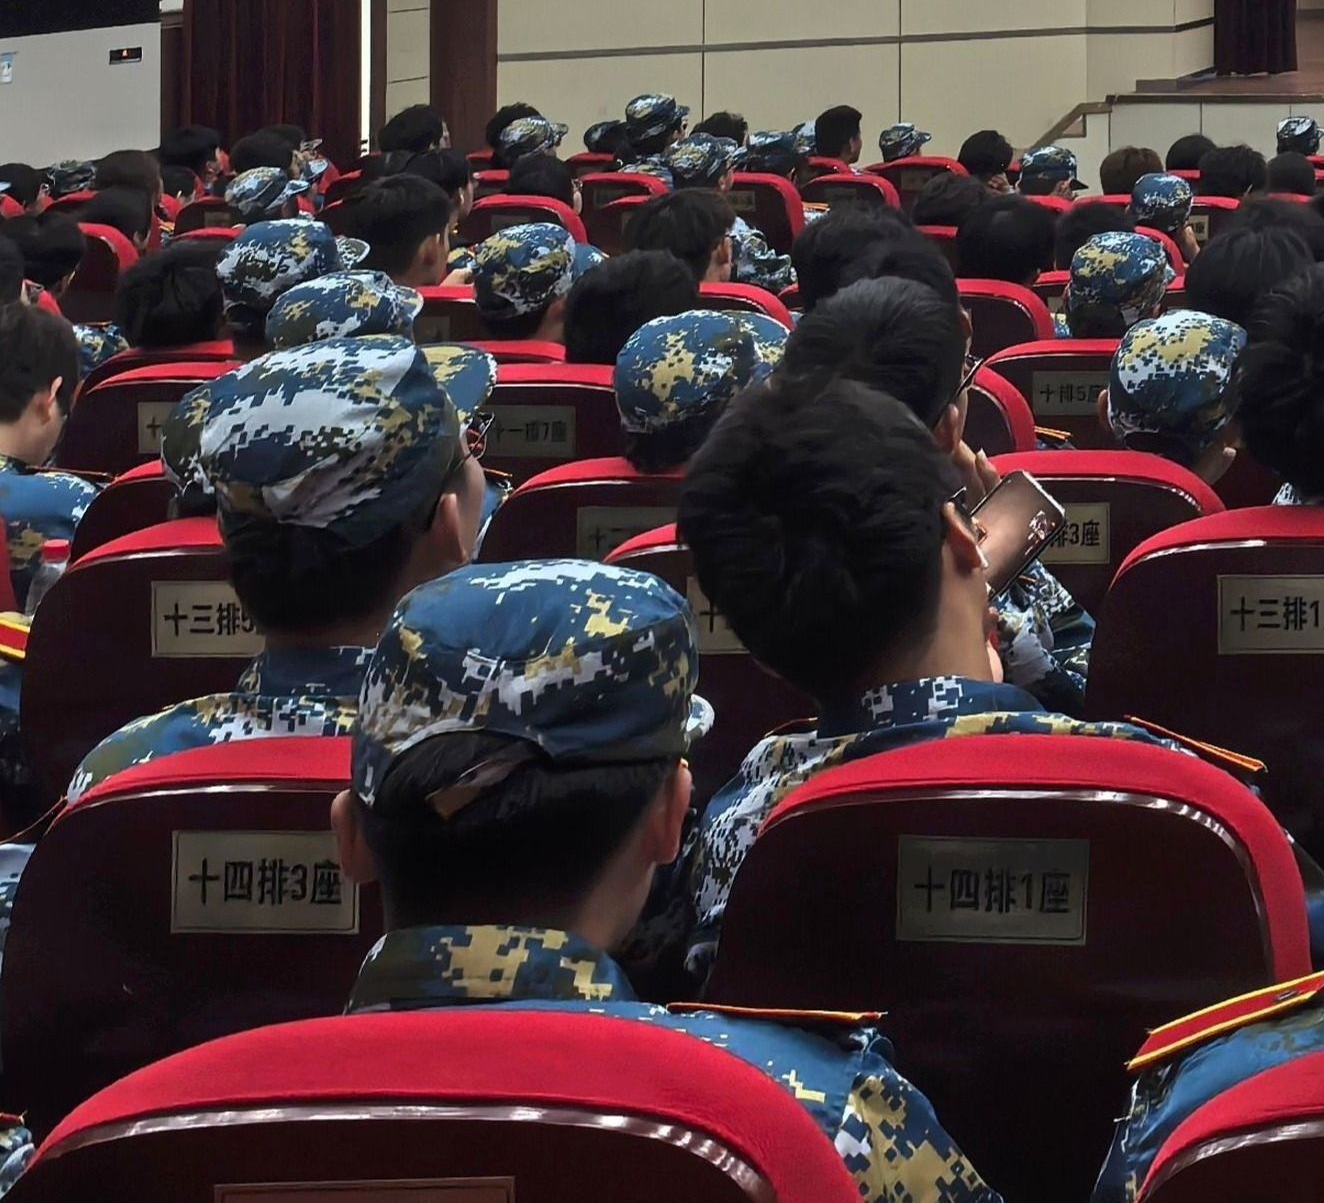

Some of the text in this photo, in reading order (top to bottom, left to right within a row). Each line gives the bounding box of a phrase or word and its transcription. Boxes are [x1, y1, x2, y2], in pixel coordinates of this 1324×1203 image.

[1048, 519, 1101, 548] 排3座
[188, 858, 343, 908] 十四排3座
[913, 864, 1071, 915] 十四排1座
